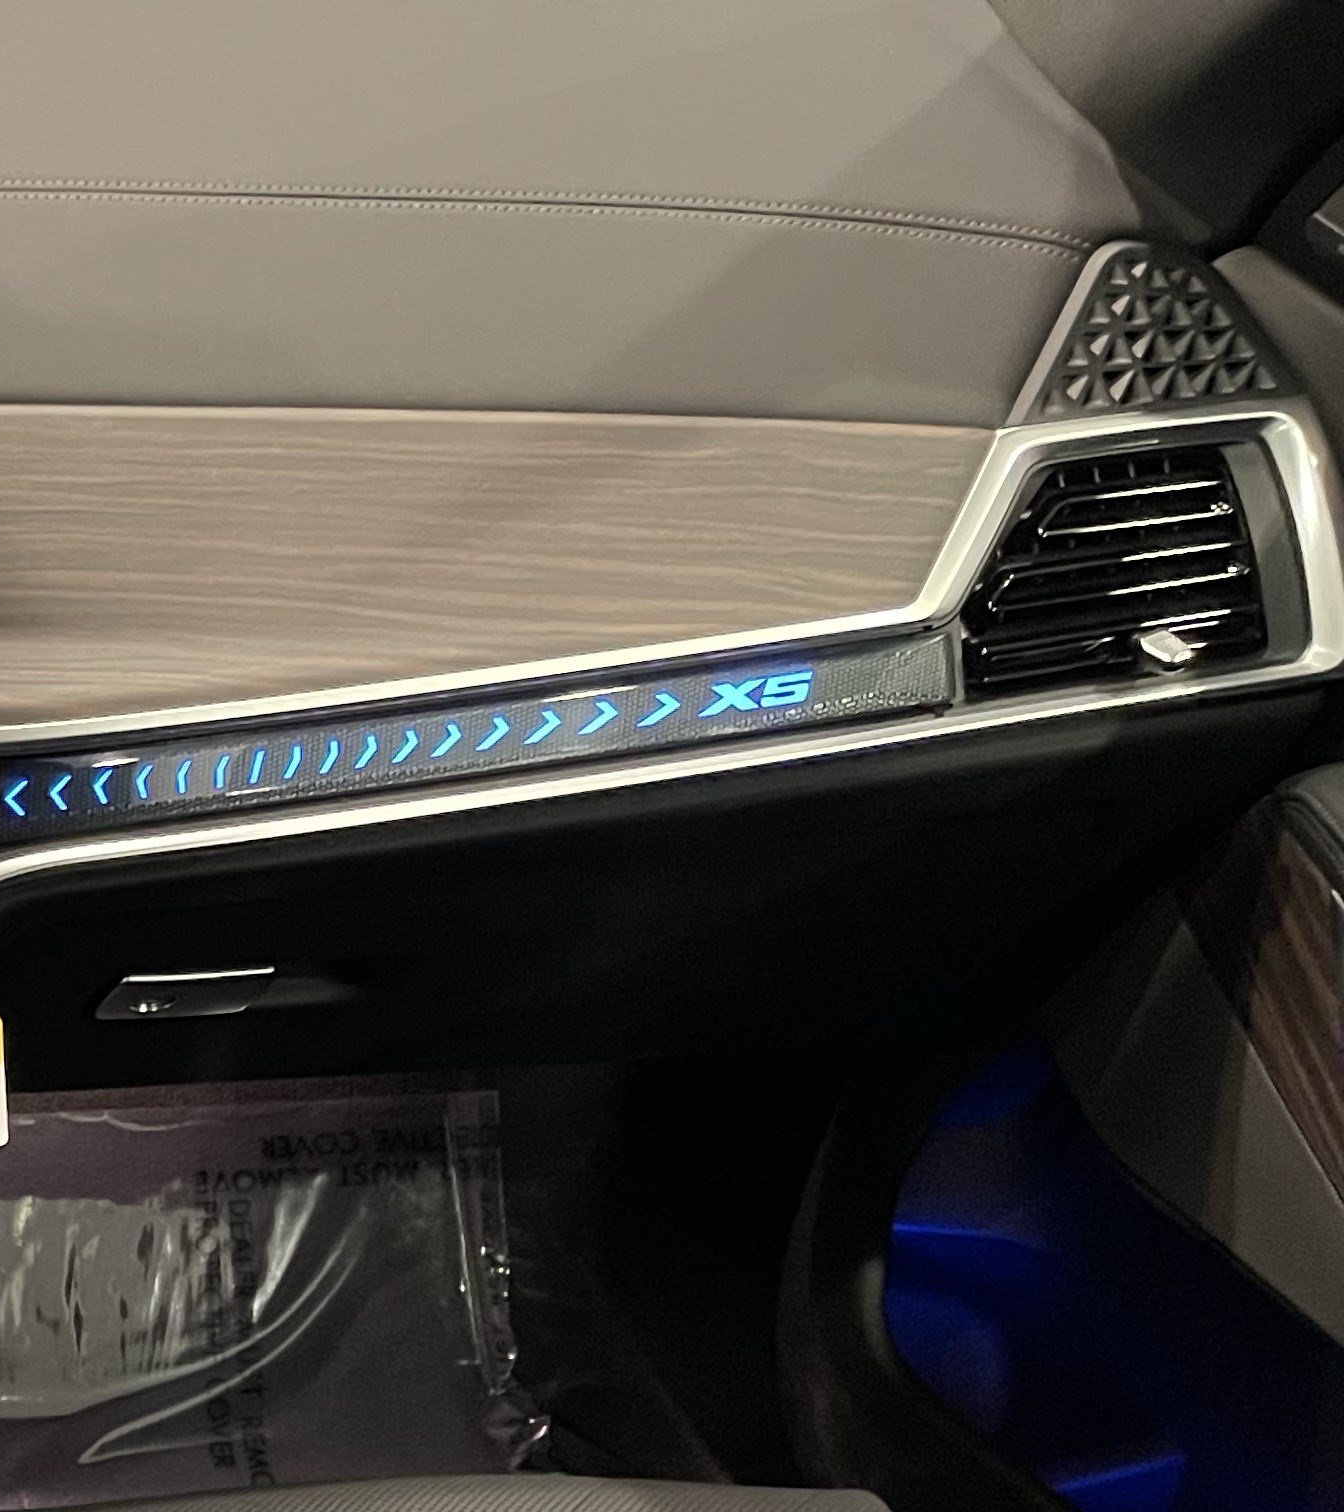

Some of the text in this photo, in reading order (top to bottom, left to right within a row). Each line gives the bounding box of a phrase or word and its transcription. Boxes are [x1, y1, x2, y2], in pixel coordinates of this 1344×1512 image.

[698, 671, 813, 718] X5
[260, 1130, 360, 1160] COVER
[229, 1199, 256, 1298] DEALER
